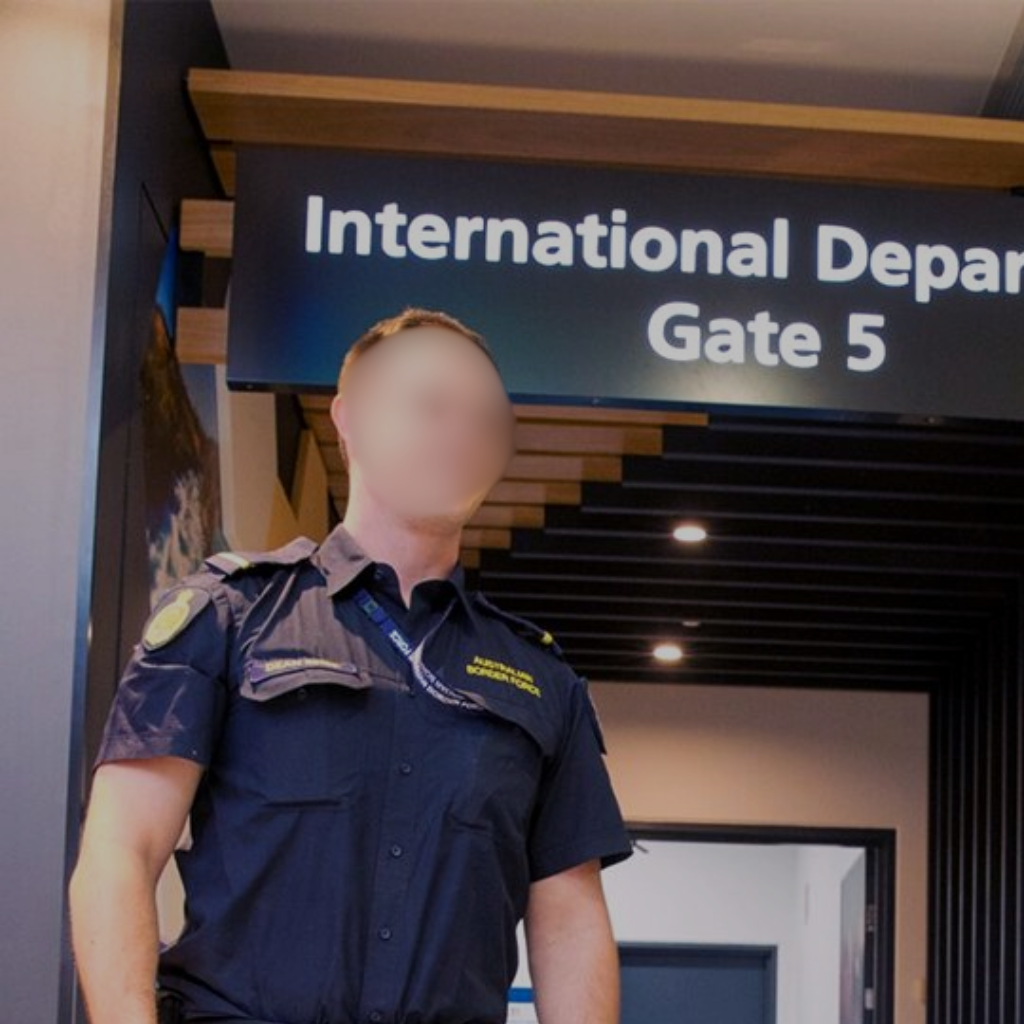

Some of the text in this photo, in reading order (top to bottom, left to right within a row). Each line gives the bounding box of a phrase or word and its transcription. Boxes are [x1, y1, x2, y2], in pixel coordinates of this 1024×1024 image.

[304, 195, 790, 279] International
[646, 301, 888, 373] Gate 5
[466, 664, 511, 683] BORDER
